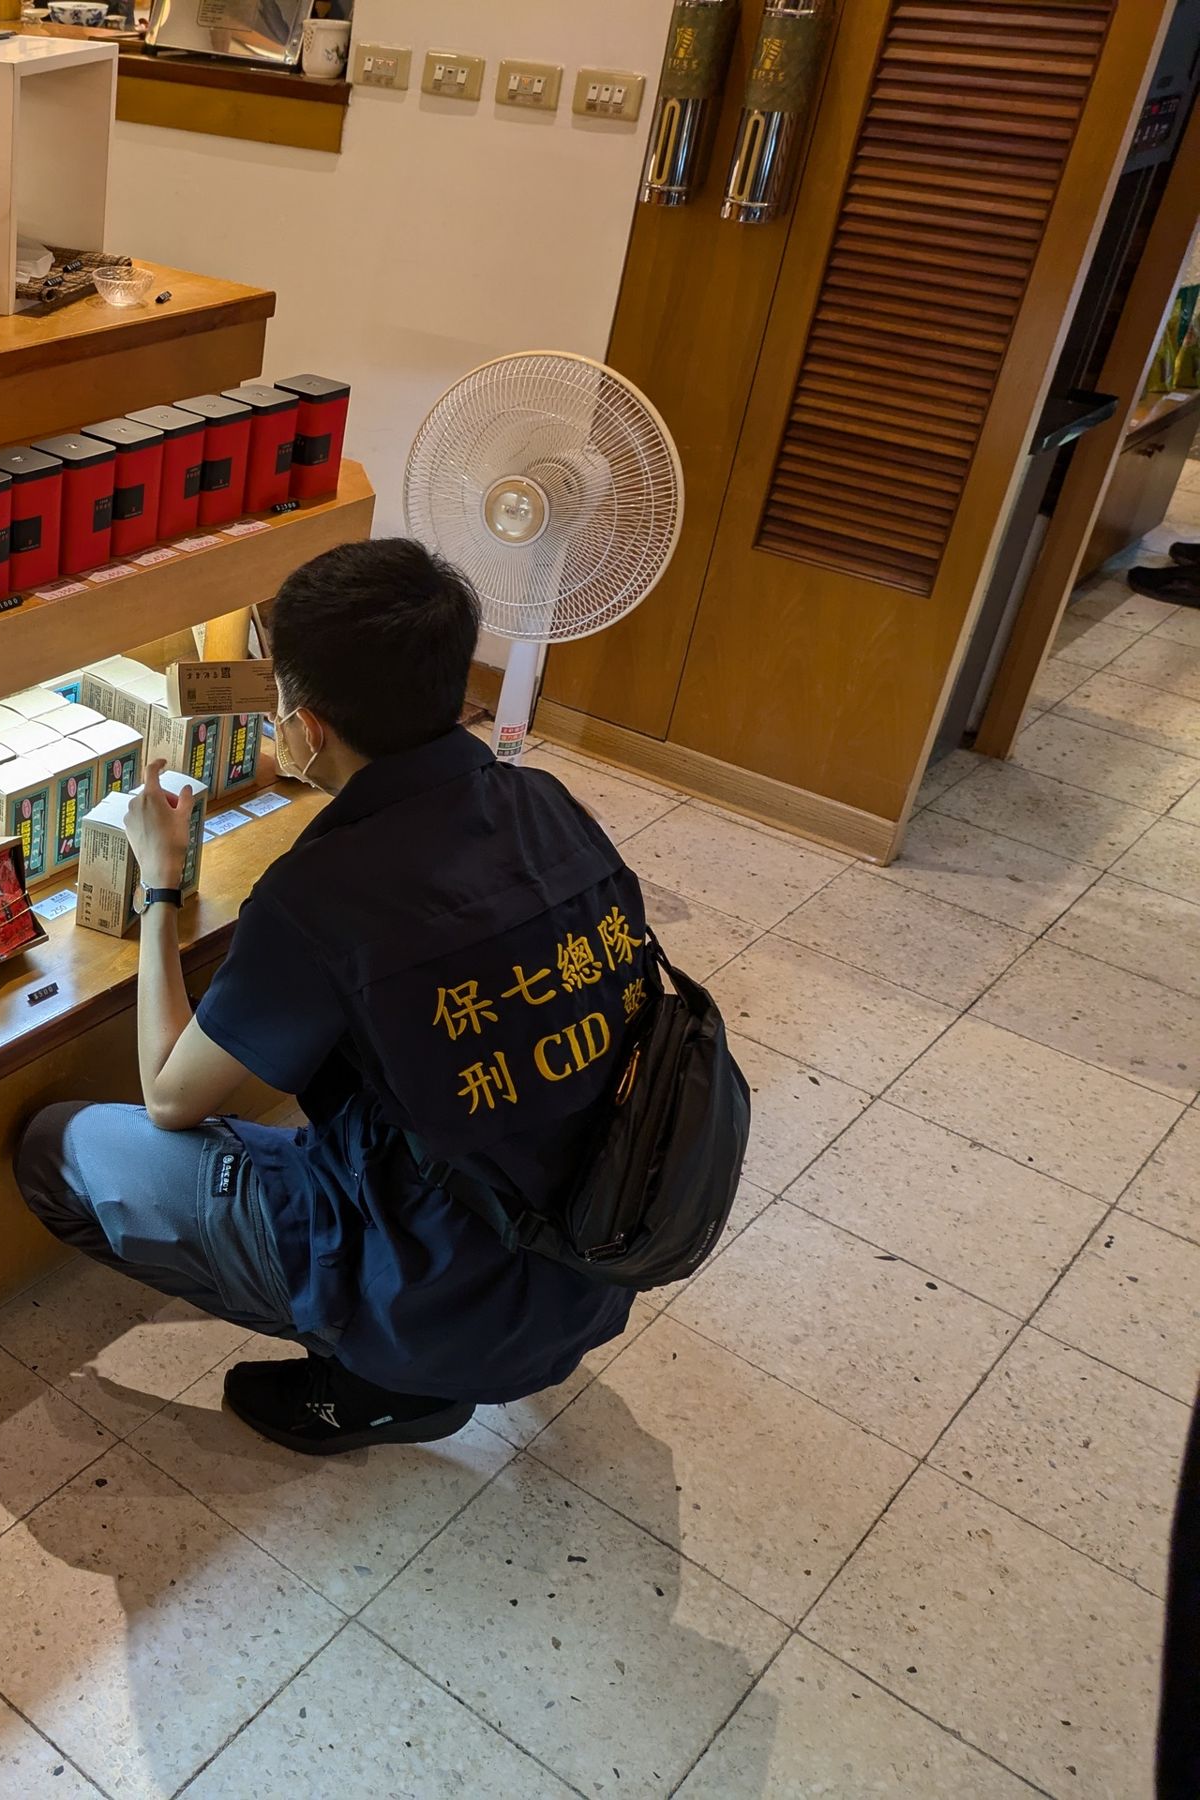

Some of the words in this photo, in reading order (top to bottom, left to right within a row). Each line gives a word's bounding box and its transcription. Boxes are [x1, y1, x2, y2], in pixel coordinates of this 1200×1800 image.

[432, 906, 642, 1041] 保七總隊
[457, 1051, 518, 1114] 刑
[534, 1012, 610, 1081] CID
